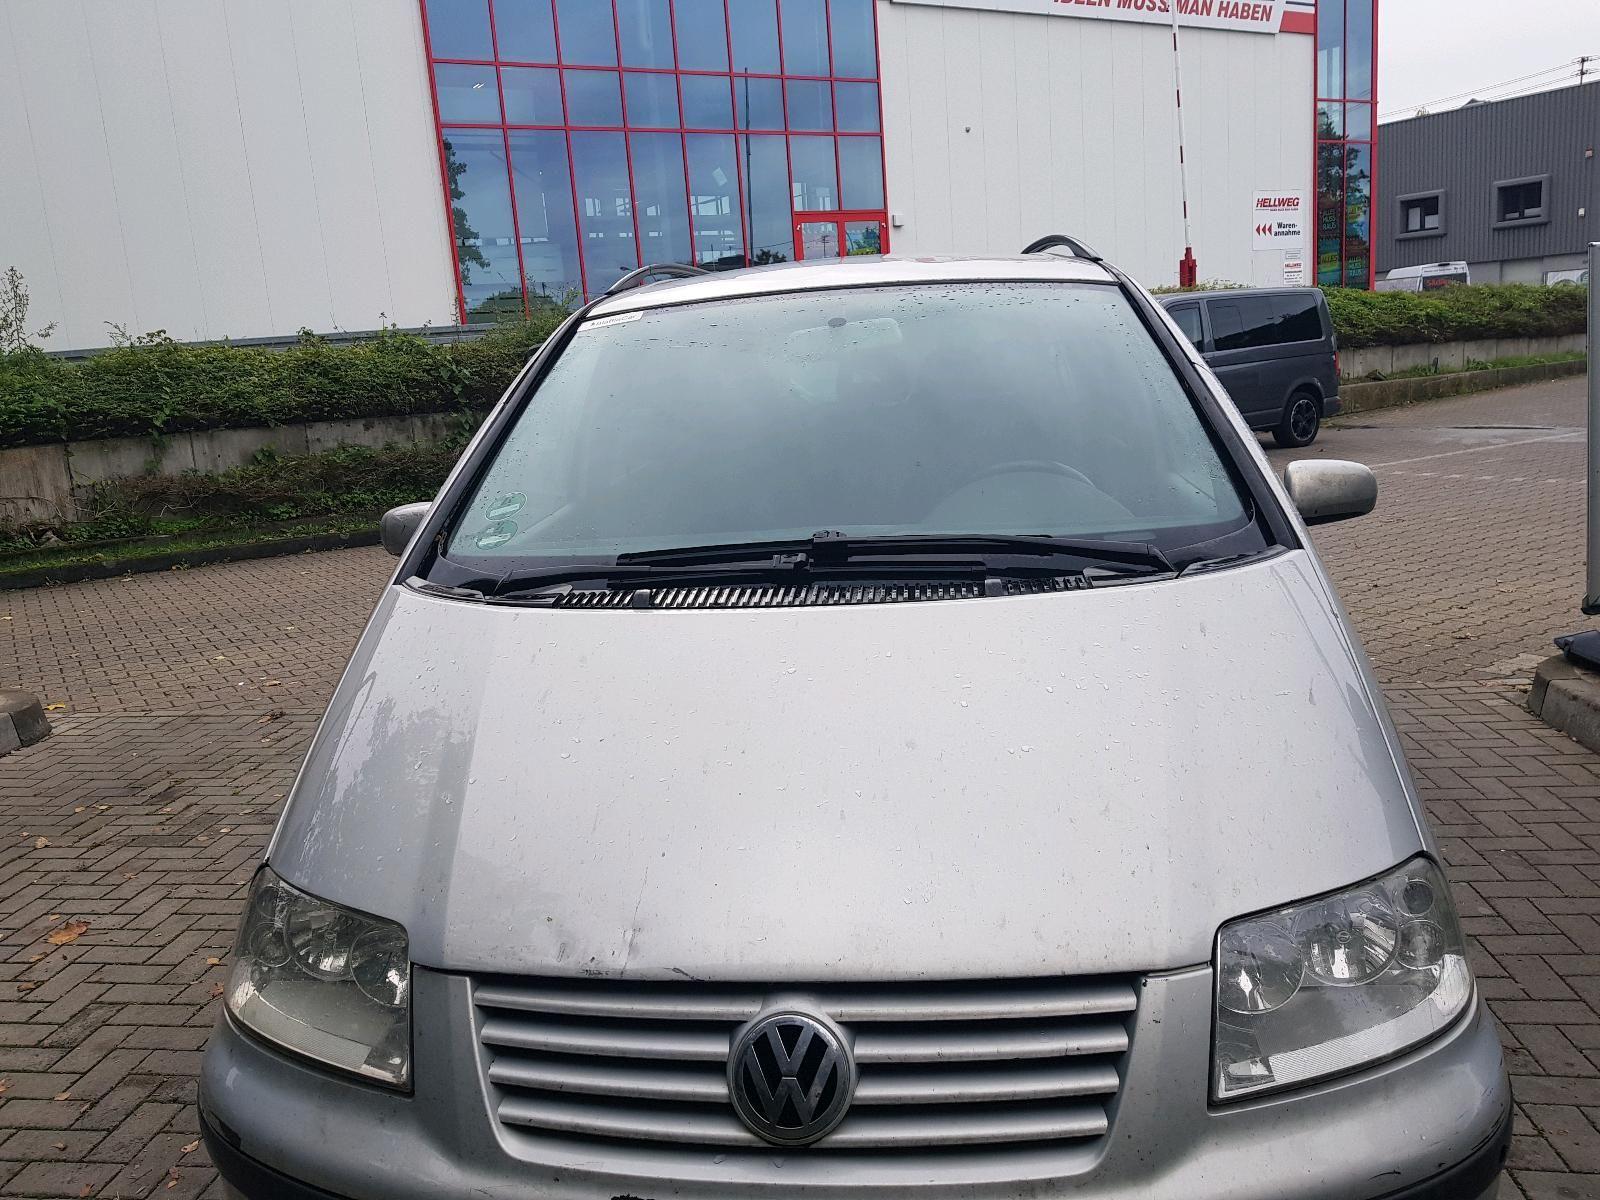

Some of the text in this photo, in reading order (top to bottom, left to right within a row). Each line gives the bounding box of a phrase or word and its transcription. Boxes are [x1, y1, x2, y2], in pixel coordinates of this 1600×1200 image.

[1176, 0, 1214, 16] MAN
[1217, 1, 1273, 22] HABEN
[1256, 197, 1300, 207] HELLWEG
[1273, 229, 1301, 237] annahme
